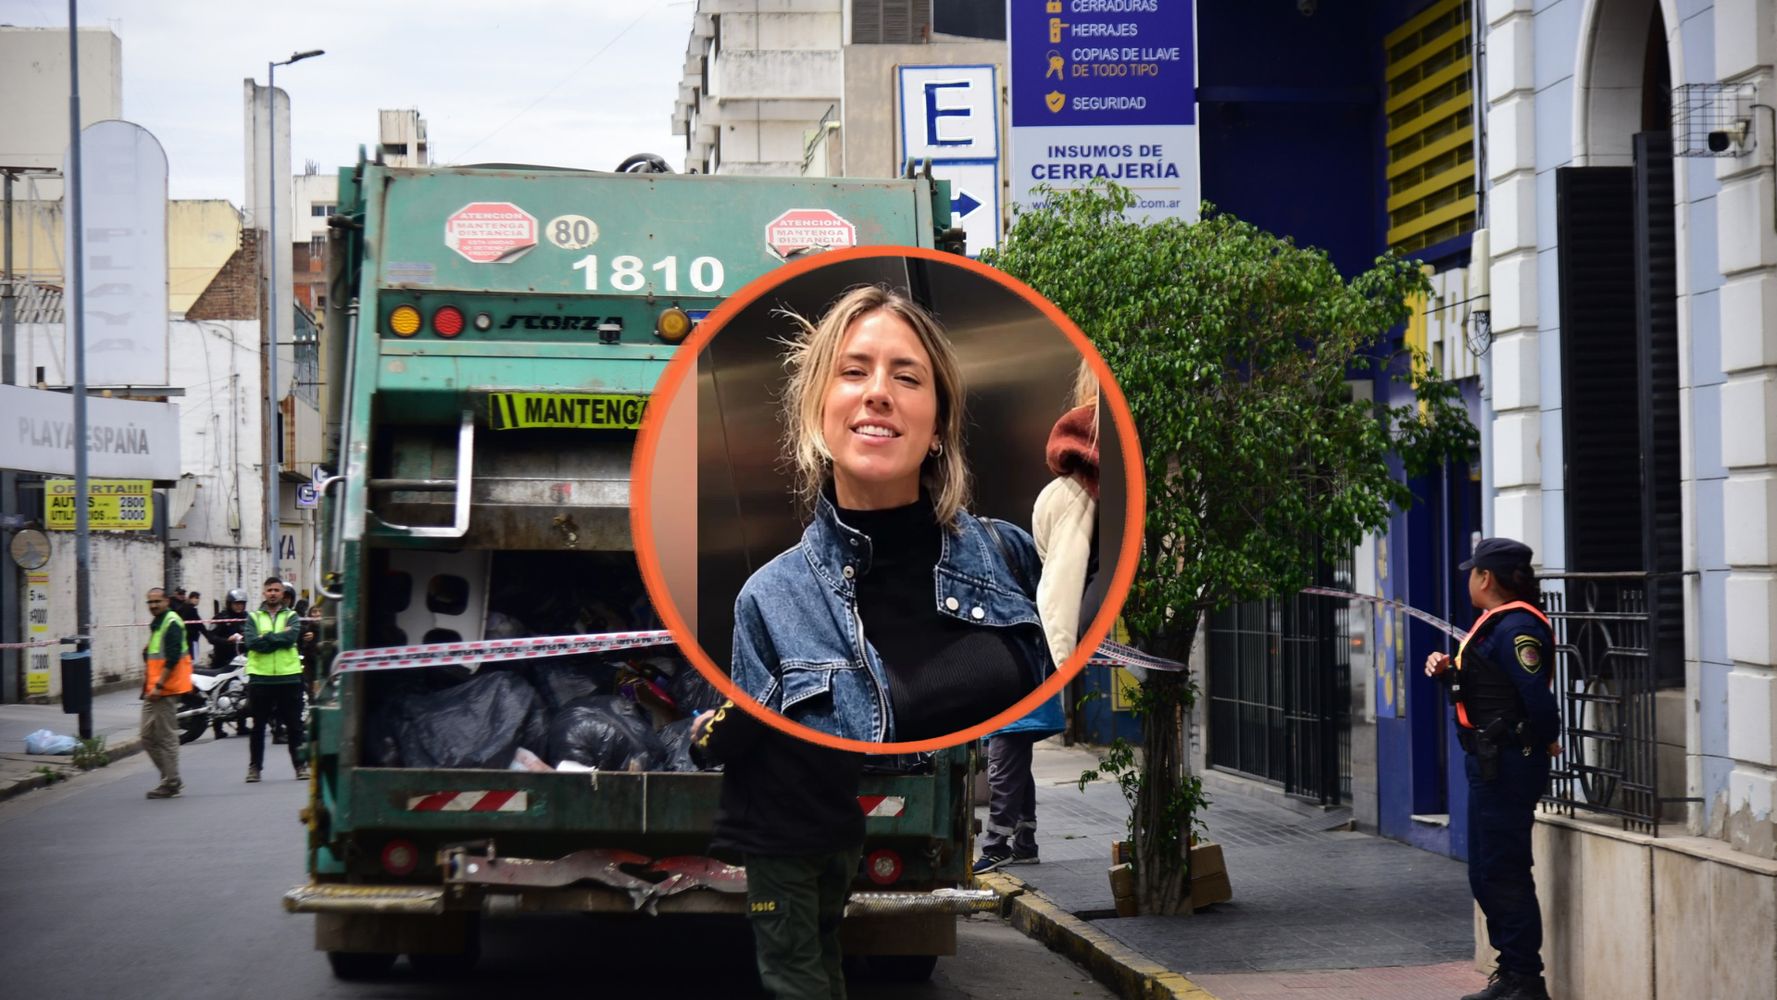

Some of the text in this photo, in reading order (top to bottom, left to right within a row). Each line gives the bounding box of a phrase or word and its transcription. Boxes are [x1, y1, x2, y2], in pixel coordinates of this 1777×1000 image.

[1071, 0, 1158, 12] CERRADURAS
[1071, 23, 1138, 36] HERRAJES
[1072, 47, 1180, 60] COPIAS DE LLAVE
[1072, 64, 1158, 76] DE TODO TIPO
[1072, 96, 1146, 109] SEGURIDAD
[924, 81, 973, 146] E
[1048, 144, 1163, 158] INSUMOS DE
[1031, 159, 1180, 180] CERRAJERÍA
[459, 212, 523, 220] ATENCION
[779, 219, 841, 227] ATENCION
[555, 220, 590, 245] 80
[776, 229, 844, 237] MANTENGA
[572, 254, 725, 292] 1810
[19, 417, 149, 454] PLAYA ESPAÑA
[53, 484, 144, 494] OFRTA!!!
[52, 496, 95, 508] AUTS
[119, 496, 146, 508] 2800
[119, 509, 146, 521] 3000
